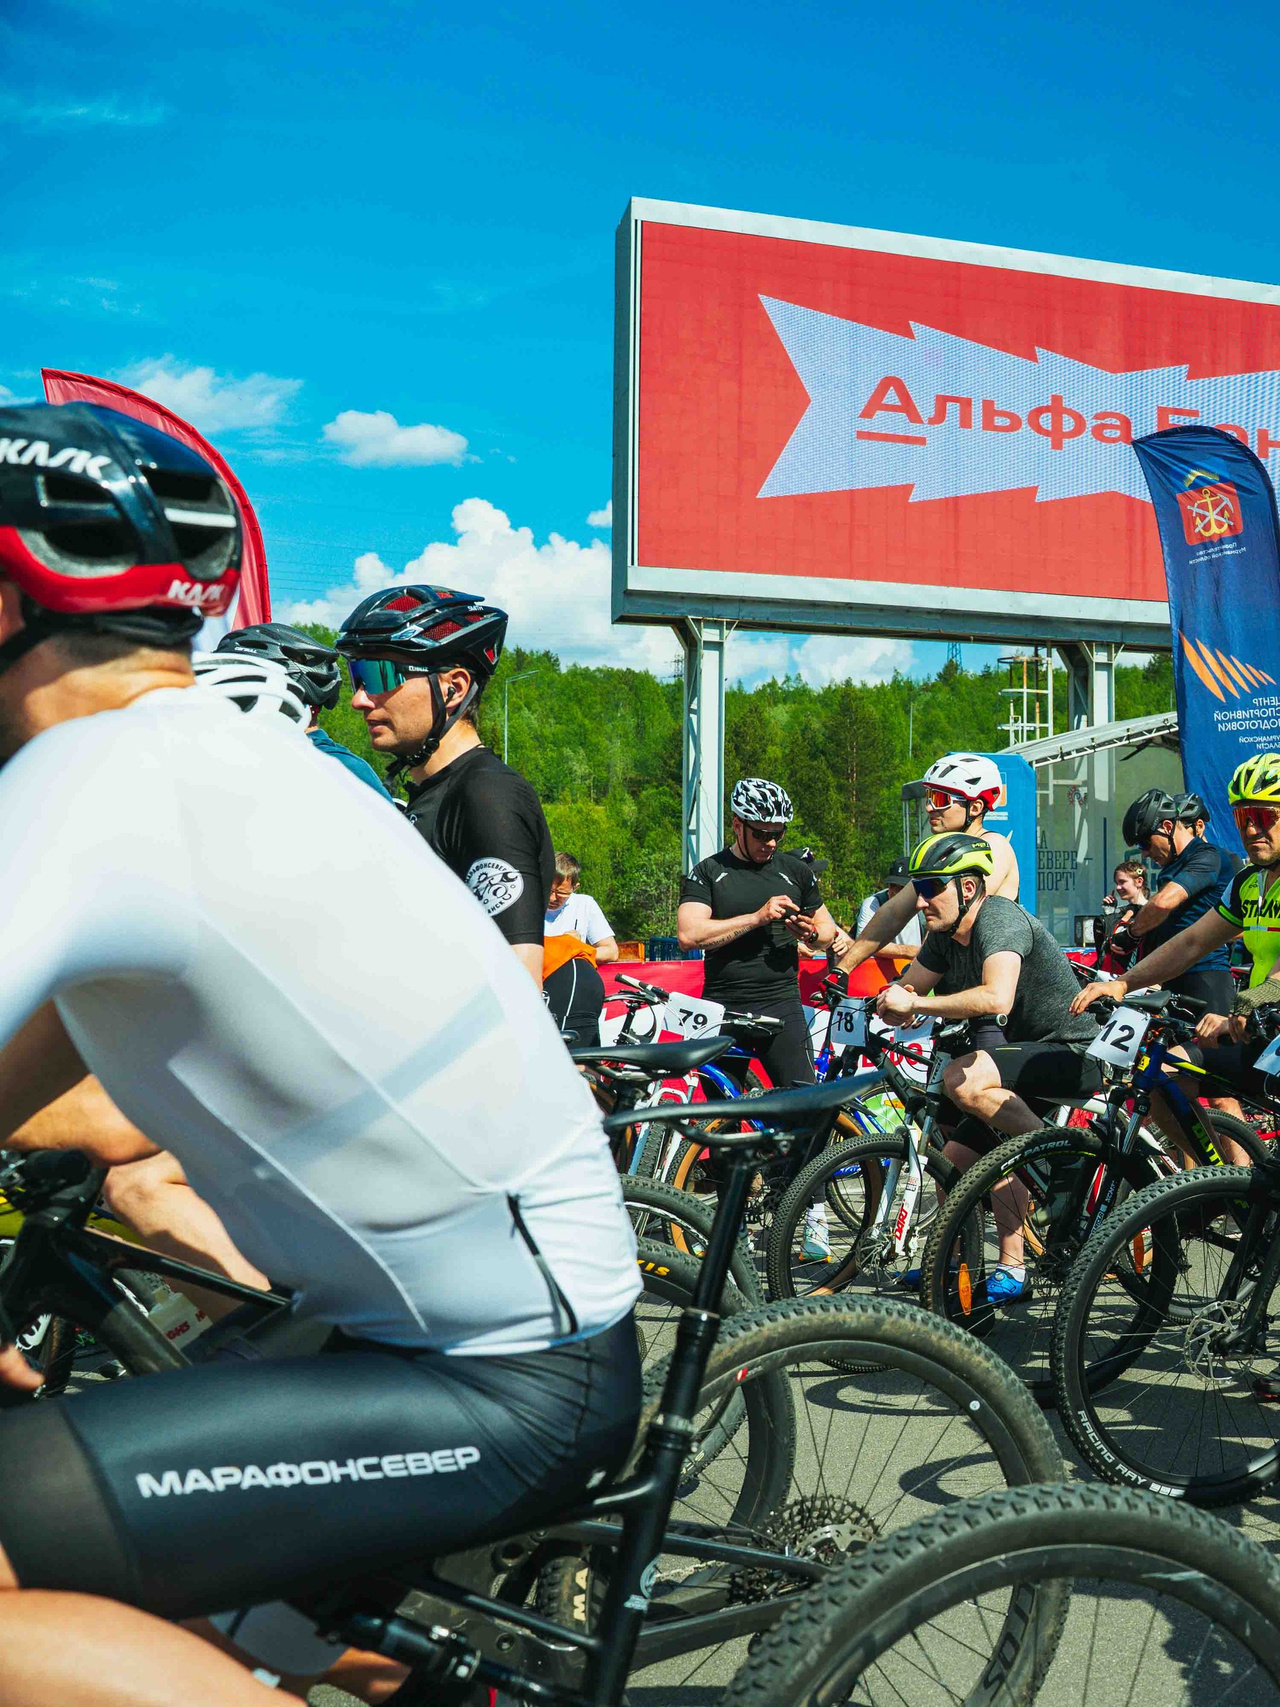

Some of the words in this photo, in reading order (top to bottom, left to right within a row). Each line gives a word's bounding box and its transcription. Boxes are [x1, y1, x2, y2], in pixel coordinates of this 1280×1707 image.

[858, 375, 1134, 450] Альфа
[167, 579, 226, 602] KASK
[466, 862, 507, 884] АРАФОНСЕВЕР
[678, 1008, 708, 1031] 79
[1100, 1019, 1136, 1053] 12
[1000, 1153, 1023, 1172] CST
[1024, 1139, 1072, 1156] PATROL
[1077, 1410, 1116, 1464] RACING
[1115, 1463, 1148, 1485] RAY
[135, 1445, 482, 1498] МАРАФОНСЕВЕР
